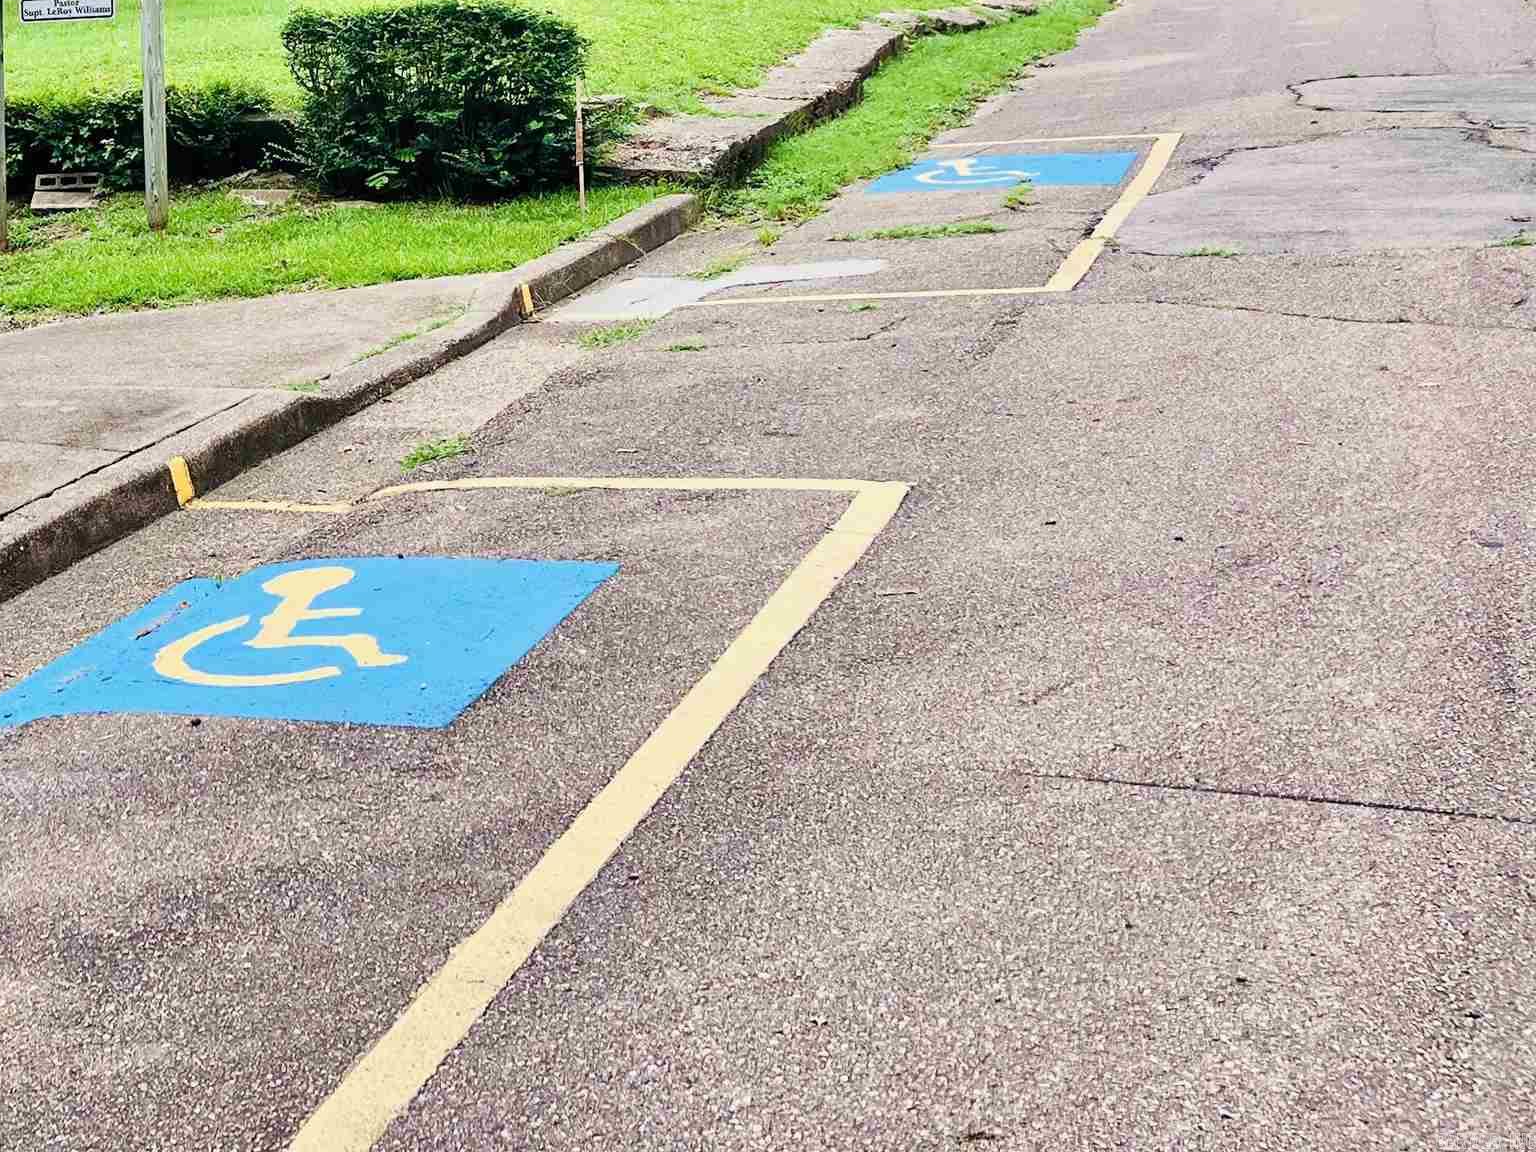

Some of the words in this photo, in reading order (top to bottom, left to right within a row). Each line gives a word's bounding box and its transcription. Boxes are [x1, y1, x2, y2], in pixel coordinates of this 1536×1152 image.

[54, 0, 79, 7] Pastor
[47, 8, 73, 16] LeRoy
[75, 6, 111, 14] Williams
